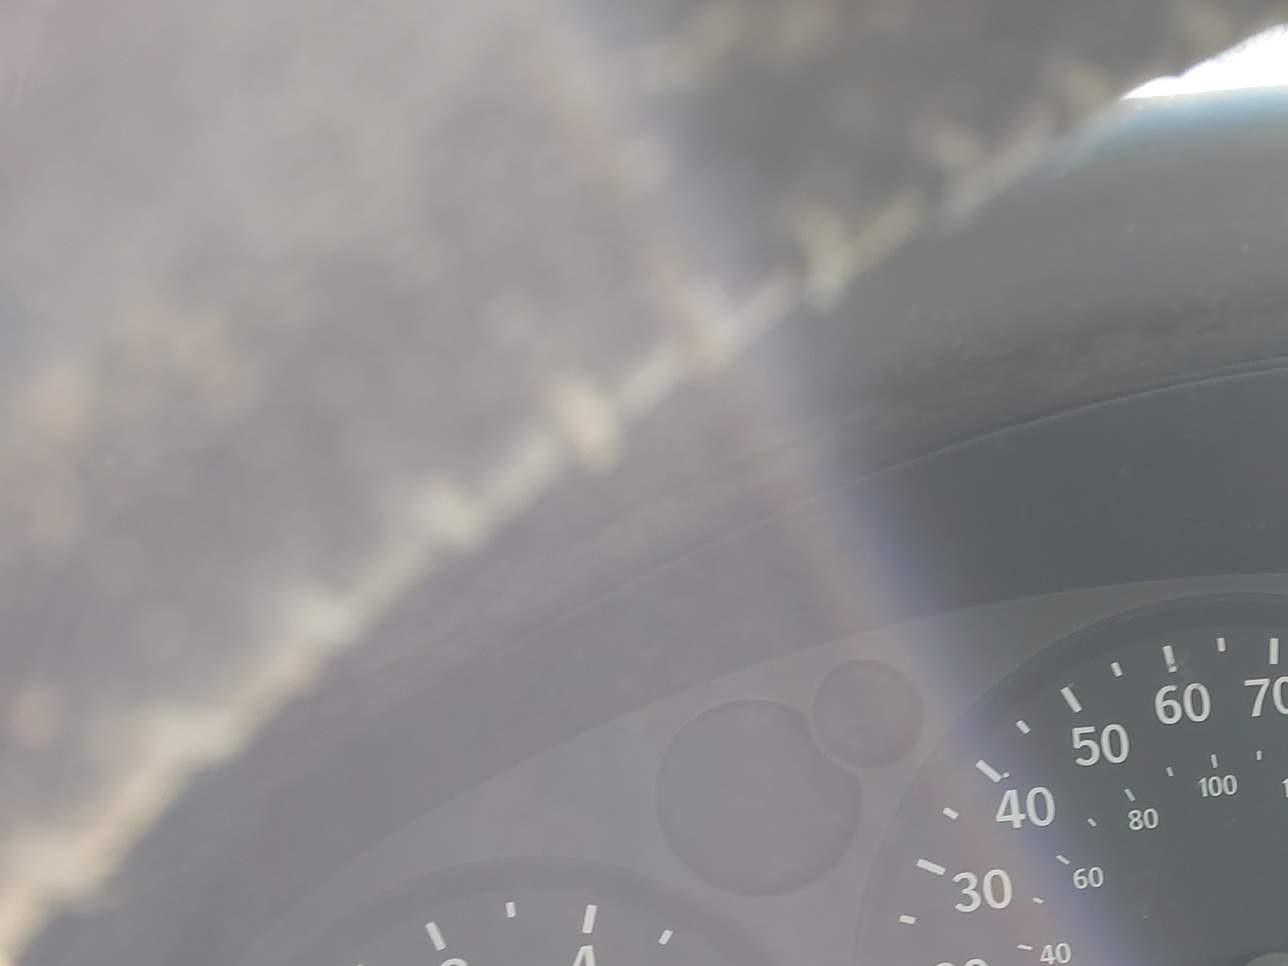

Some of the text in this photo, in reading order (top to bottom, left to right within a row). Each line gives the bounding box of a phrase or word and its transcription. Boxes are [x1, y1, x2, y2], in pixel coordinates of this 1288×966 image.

[1155, 683, 1211, 724] 60
[1072, 724, 1129, 766] 50
[1199, 774, 1238, 798] 100
[996, 787, 1056, 828] 40
[1128, 808, 1159, 831] 80
[953, 869, 1013, 912] 30
[1072, 867, 1104, 889] 60
[1040, 943, 1072, 965] 40
